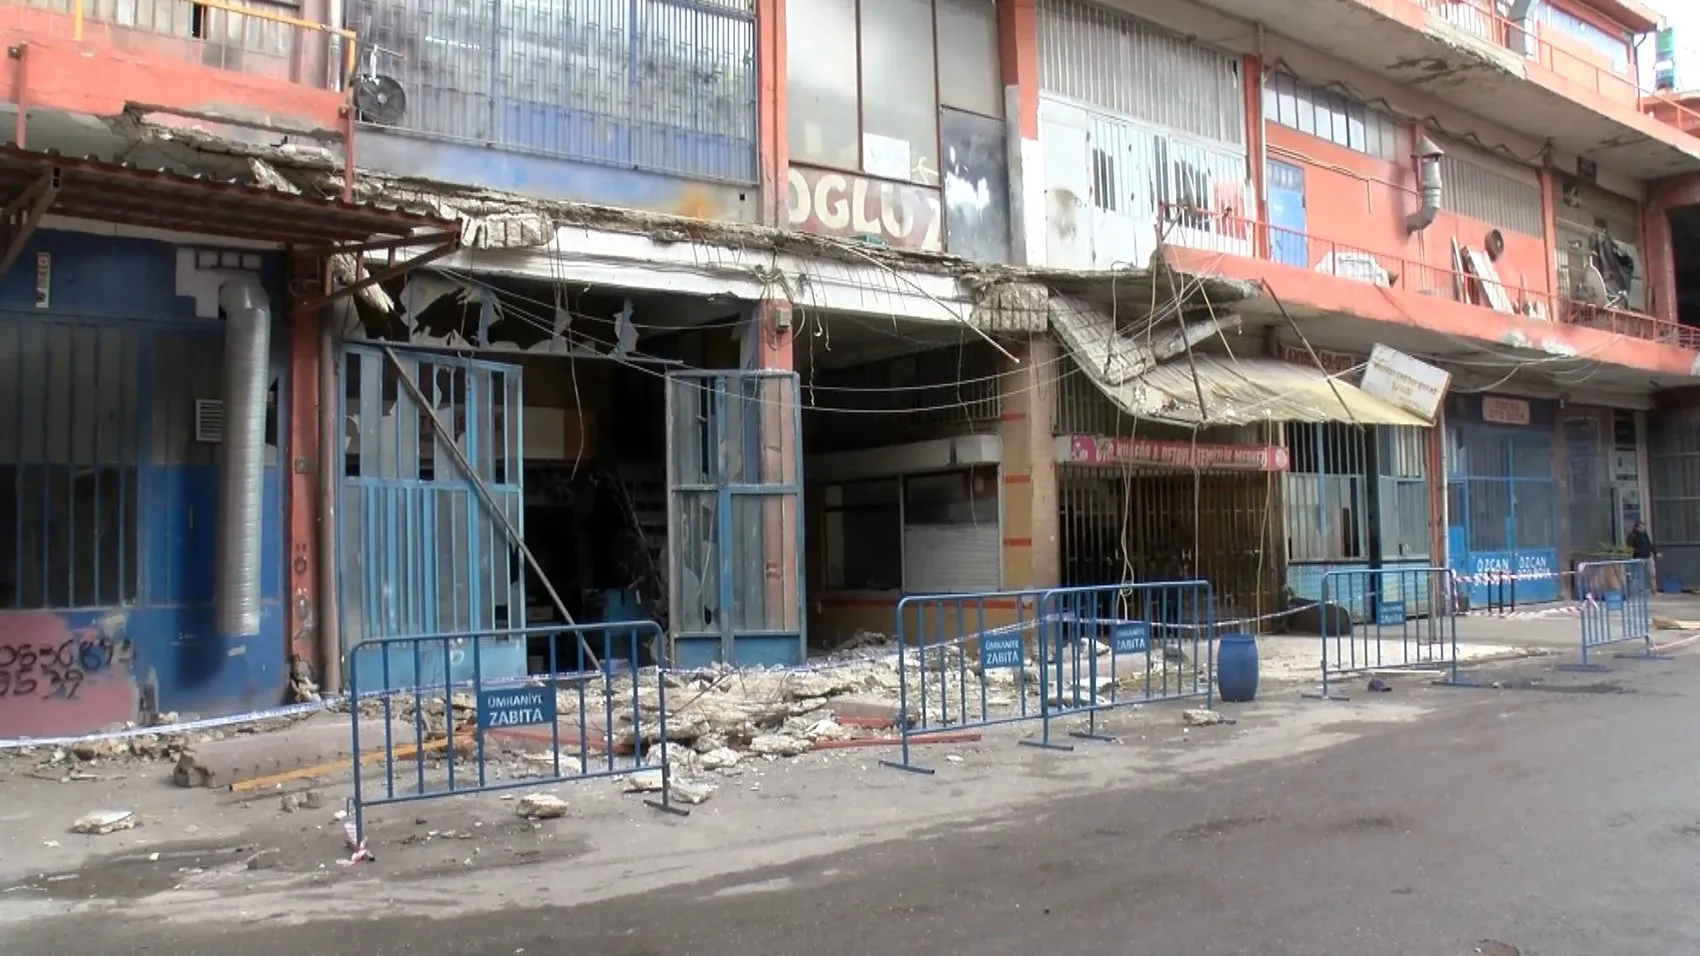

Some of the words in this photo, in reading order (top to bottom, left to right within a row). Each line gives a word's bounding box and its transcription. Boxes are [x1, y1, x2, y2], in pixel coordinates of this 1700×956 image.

[1115, 638, 1147, 651] ZABITA
[986, 651, 1020, 664] ZABITA
[489, 708, 544, 726] ZABITA
